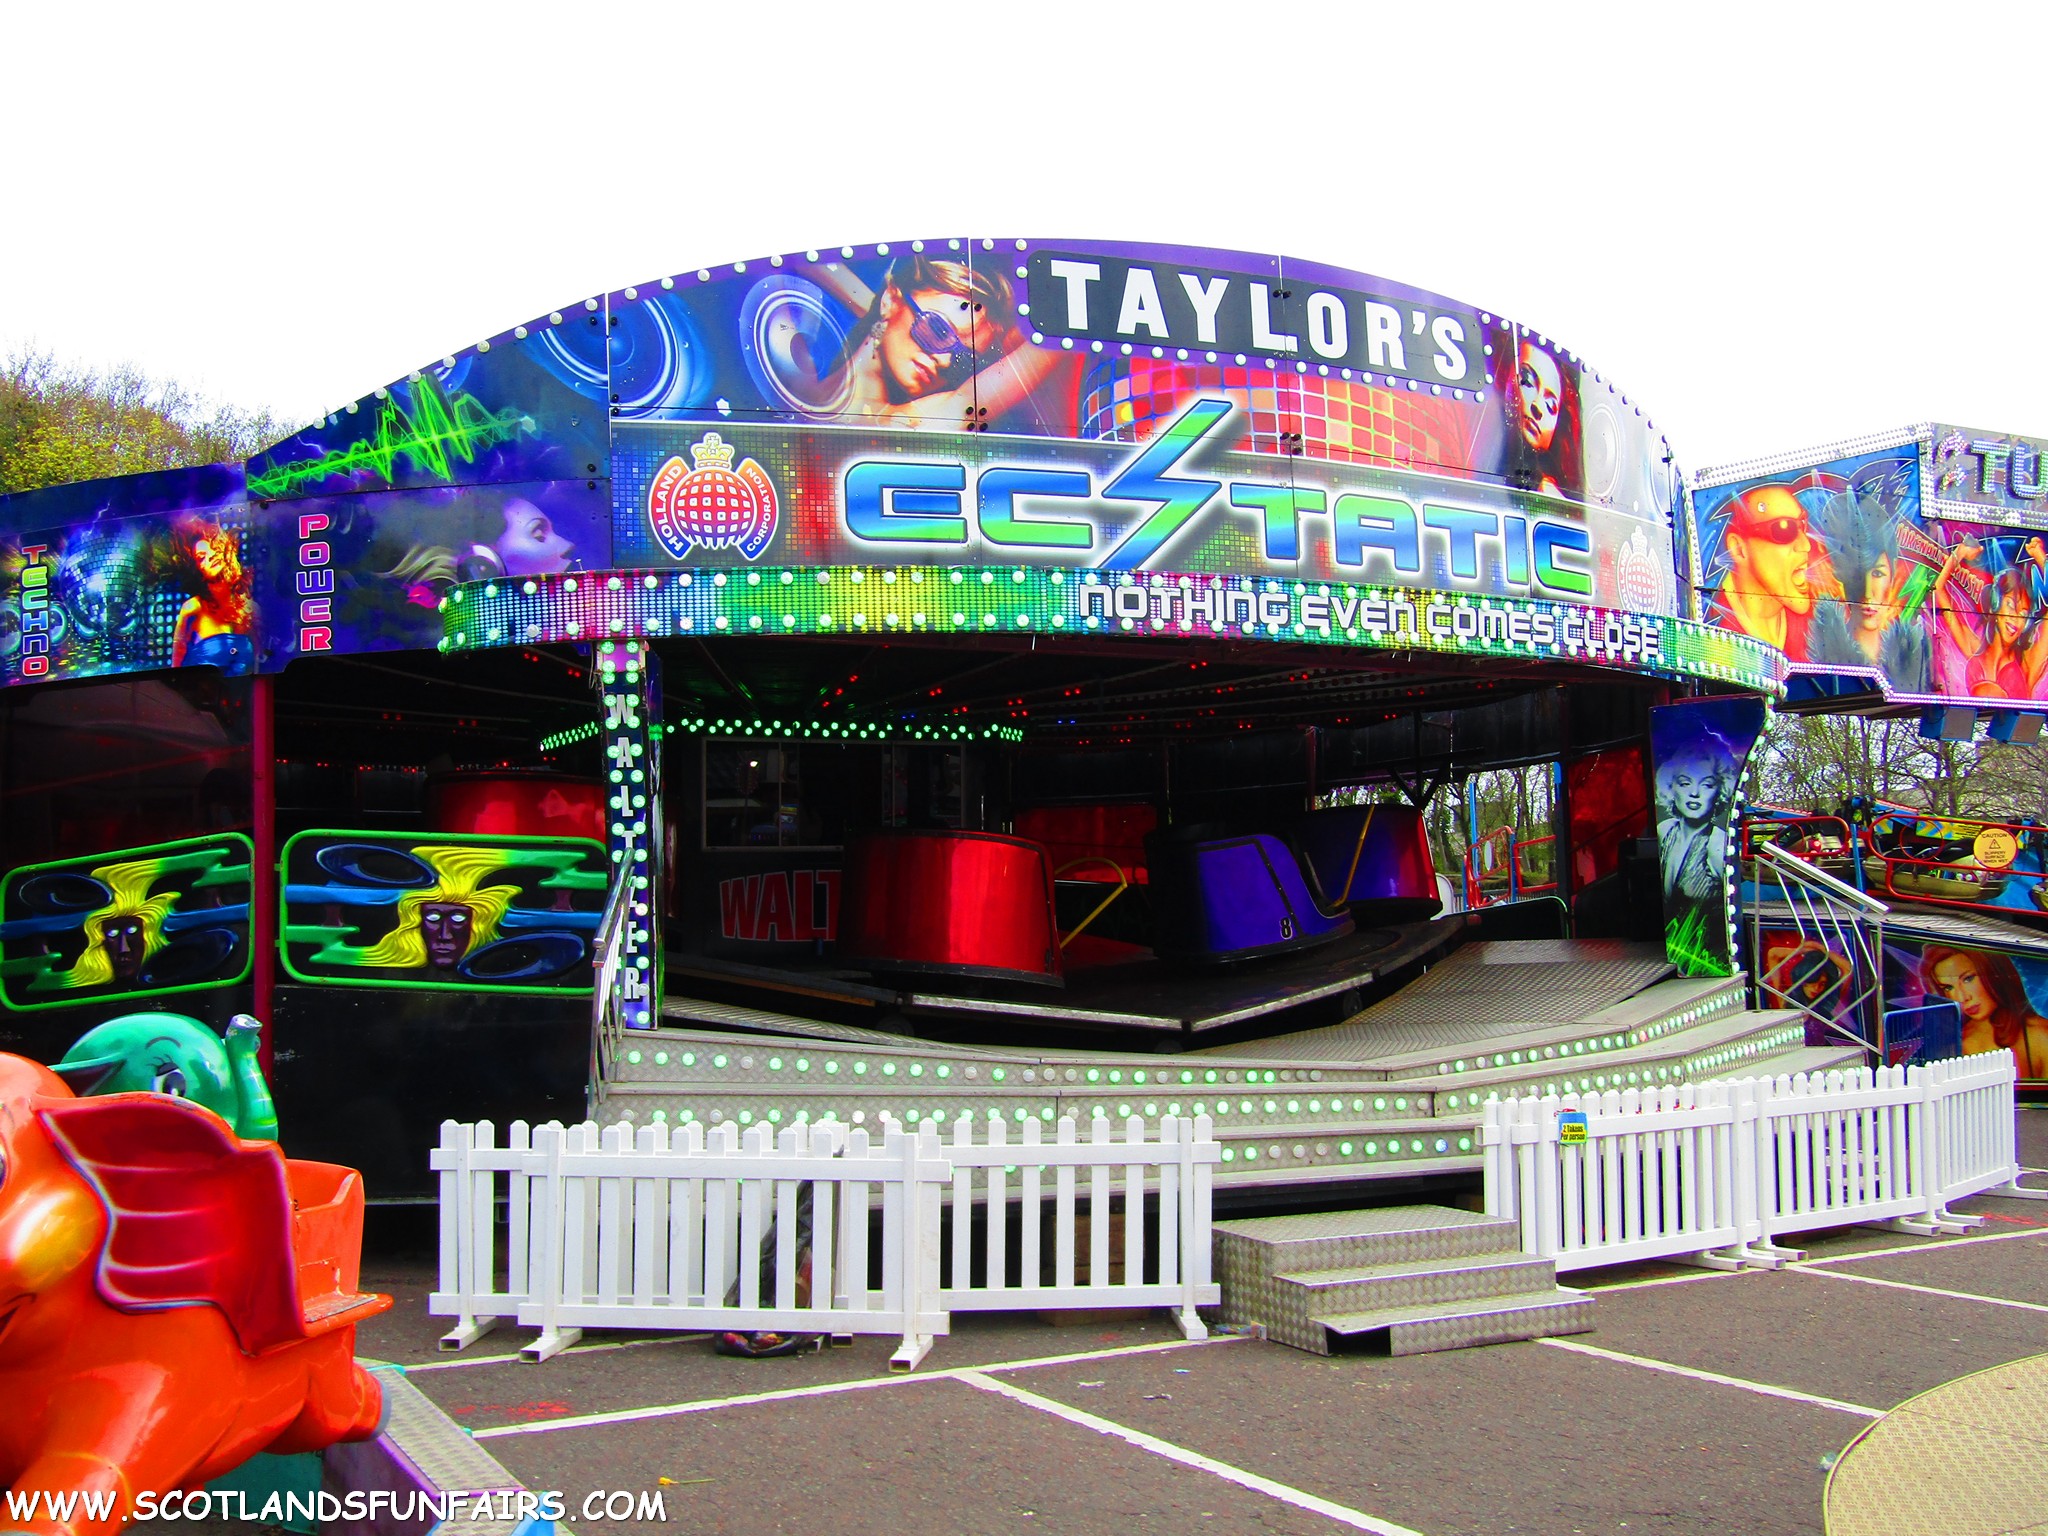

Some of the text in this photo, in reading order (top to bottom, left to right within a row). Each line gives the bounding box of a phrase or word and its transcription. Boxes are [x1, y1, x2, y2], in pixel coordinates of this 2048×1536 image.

[1050, 258, 1467, 381] TAYLOR'S
[655, 465, 684, 552] HOLLAND
[746, 467, 772, 552] CORPORATION
[21, 544, 49, 677] TECHNO
[296, 513, 335, 652] POWER
[1079, 583, 1660, 656] NOTHING EVEN COMES CLOSE
[1279, 916, 1293, 940] 8
